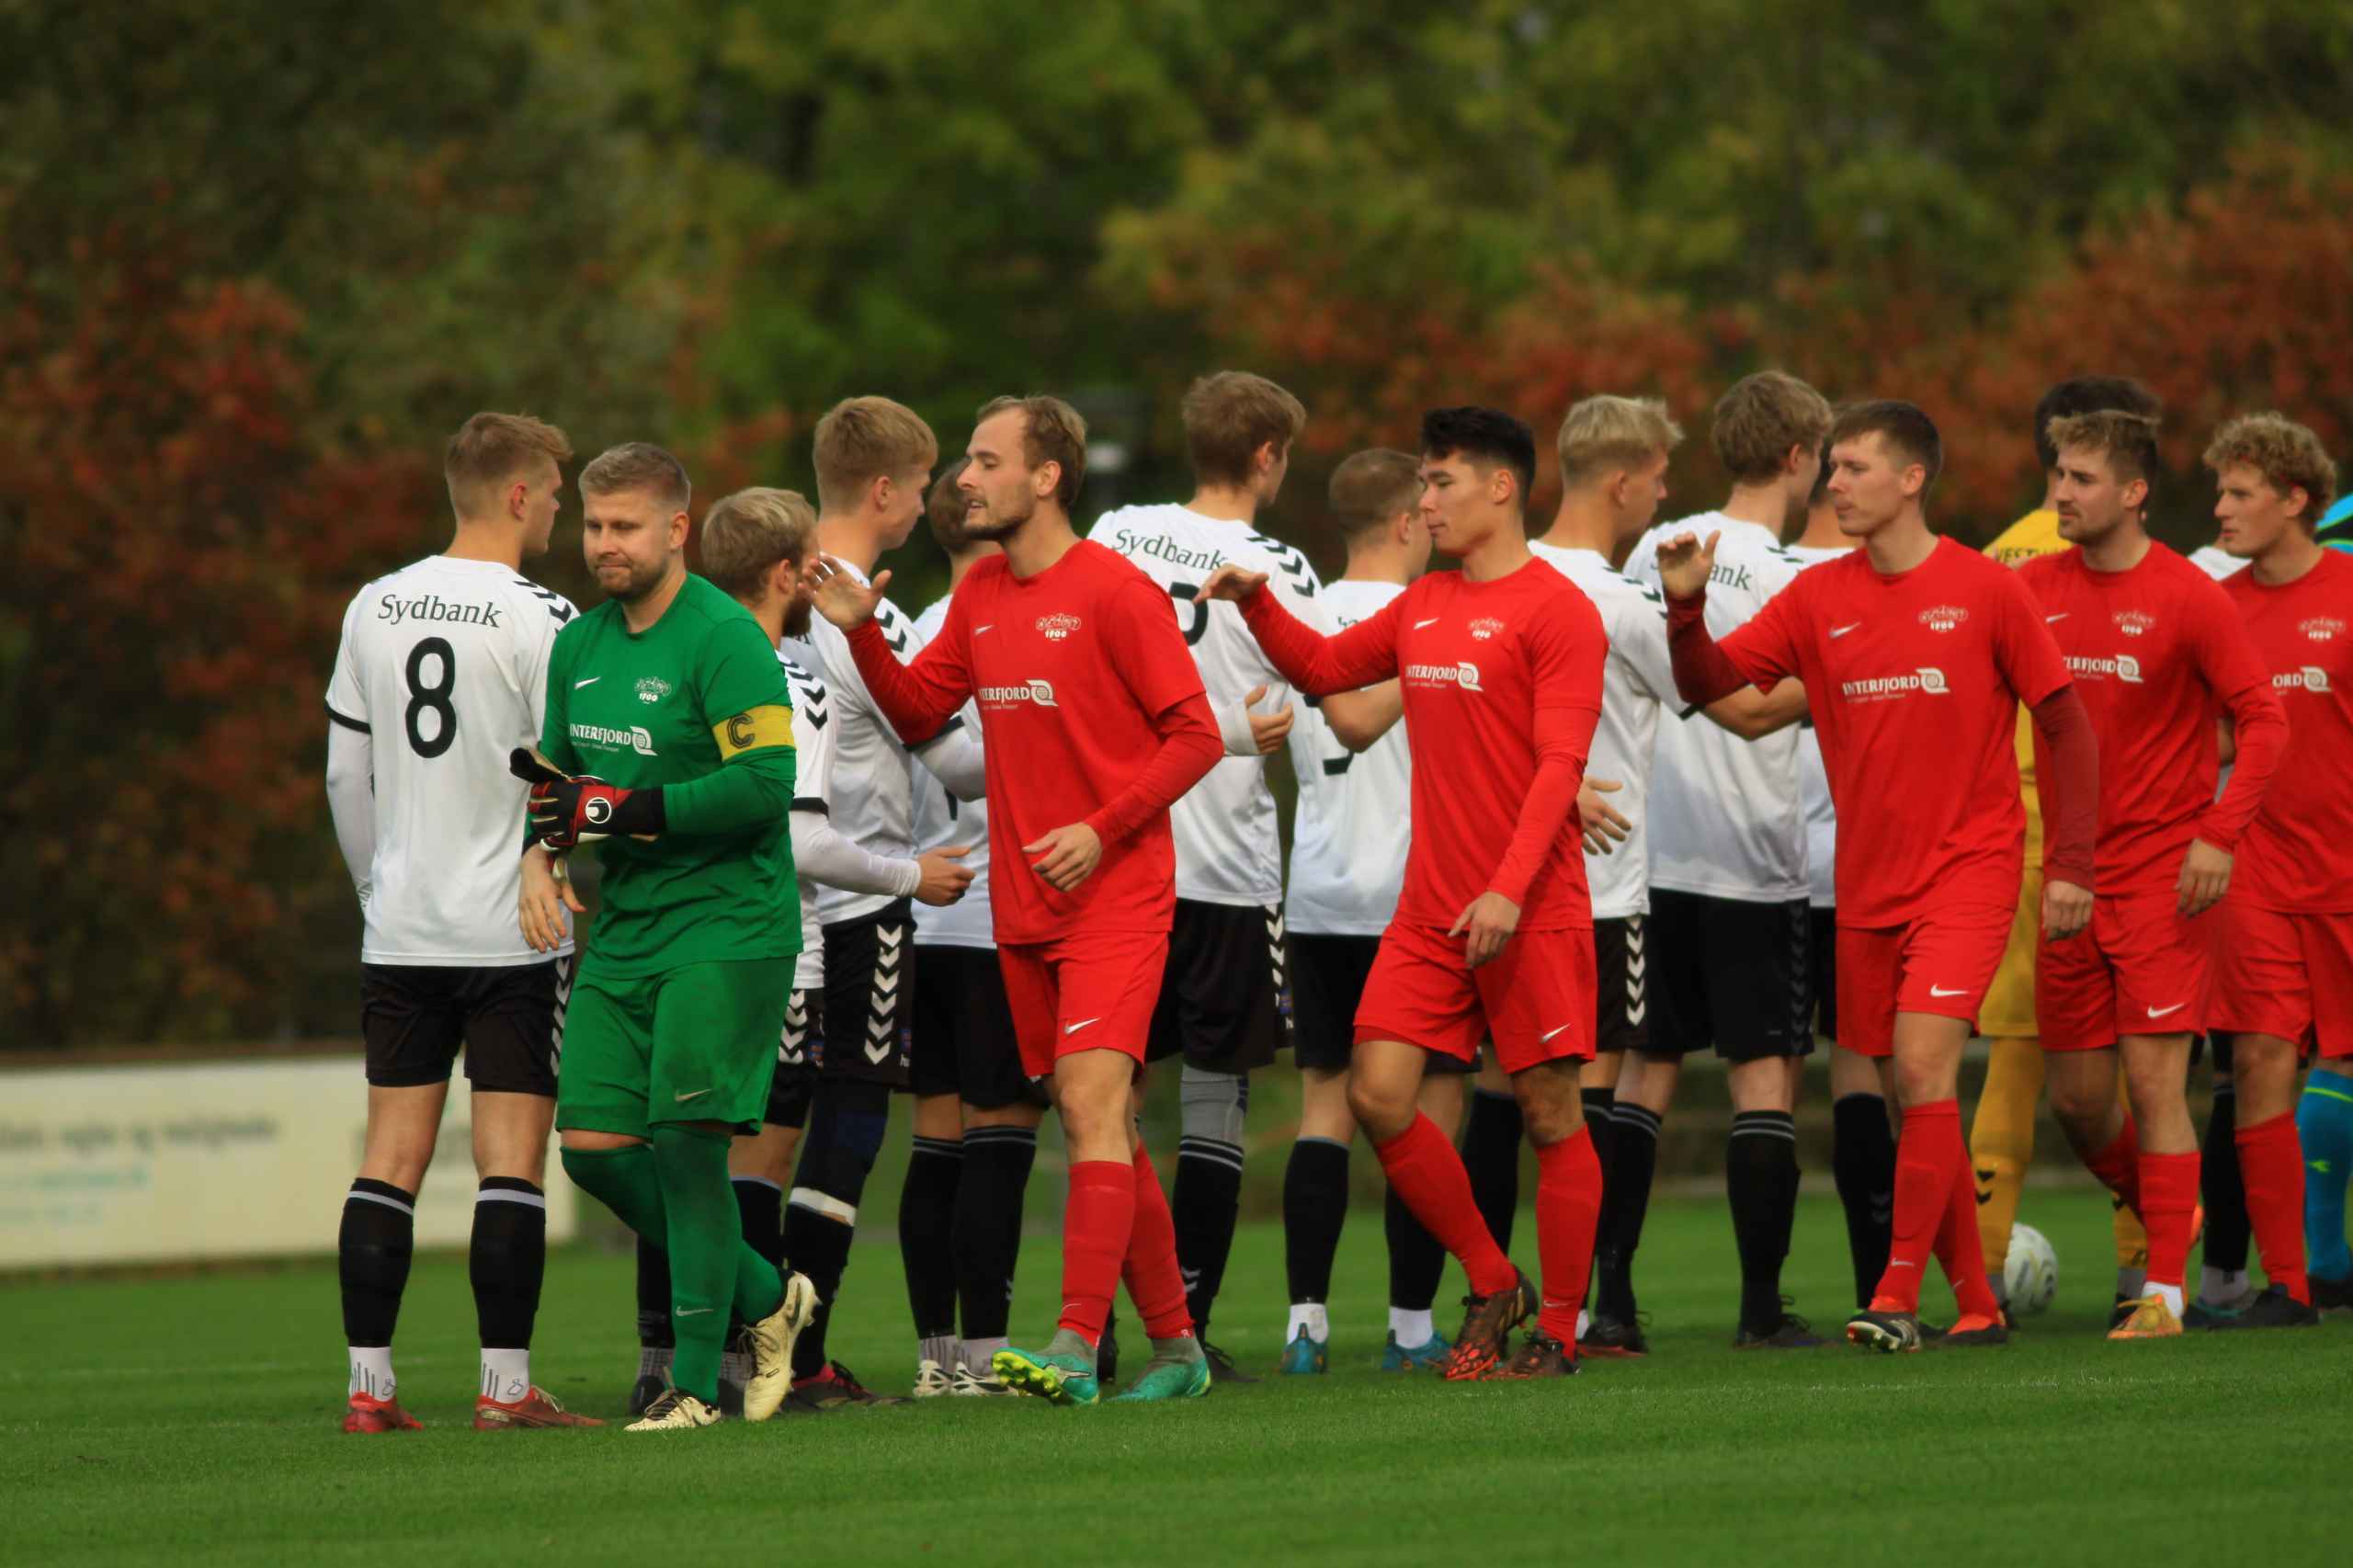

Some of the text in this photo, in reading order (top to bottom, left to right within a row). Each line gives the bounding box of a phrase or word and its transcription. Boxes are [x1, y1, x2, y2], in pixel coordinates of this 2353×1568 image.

[1111, 528, 1229, 571] Sydbank
[378, 594, 503, 629] Sydbank
[405, 636, 457, 759] 8
[569, 722, 632, 746] INTERFJORD
[727, 713, 756, 749] C
